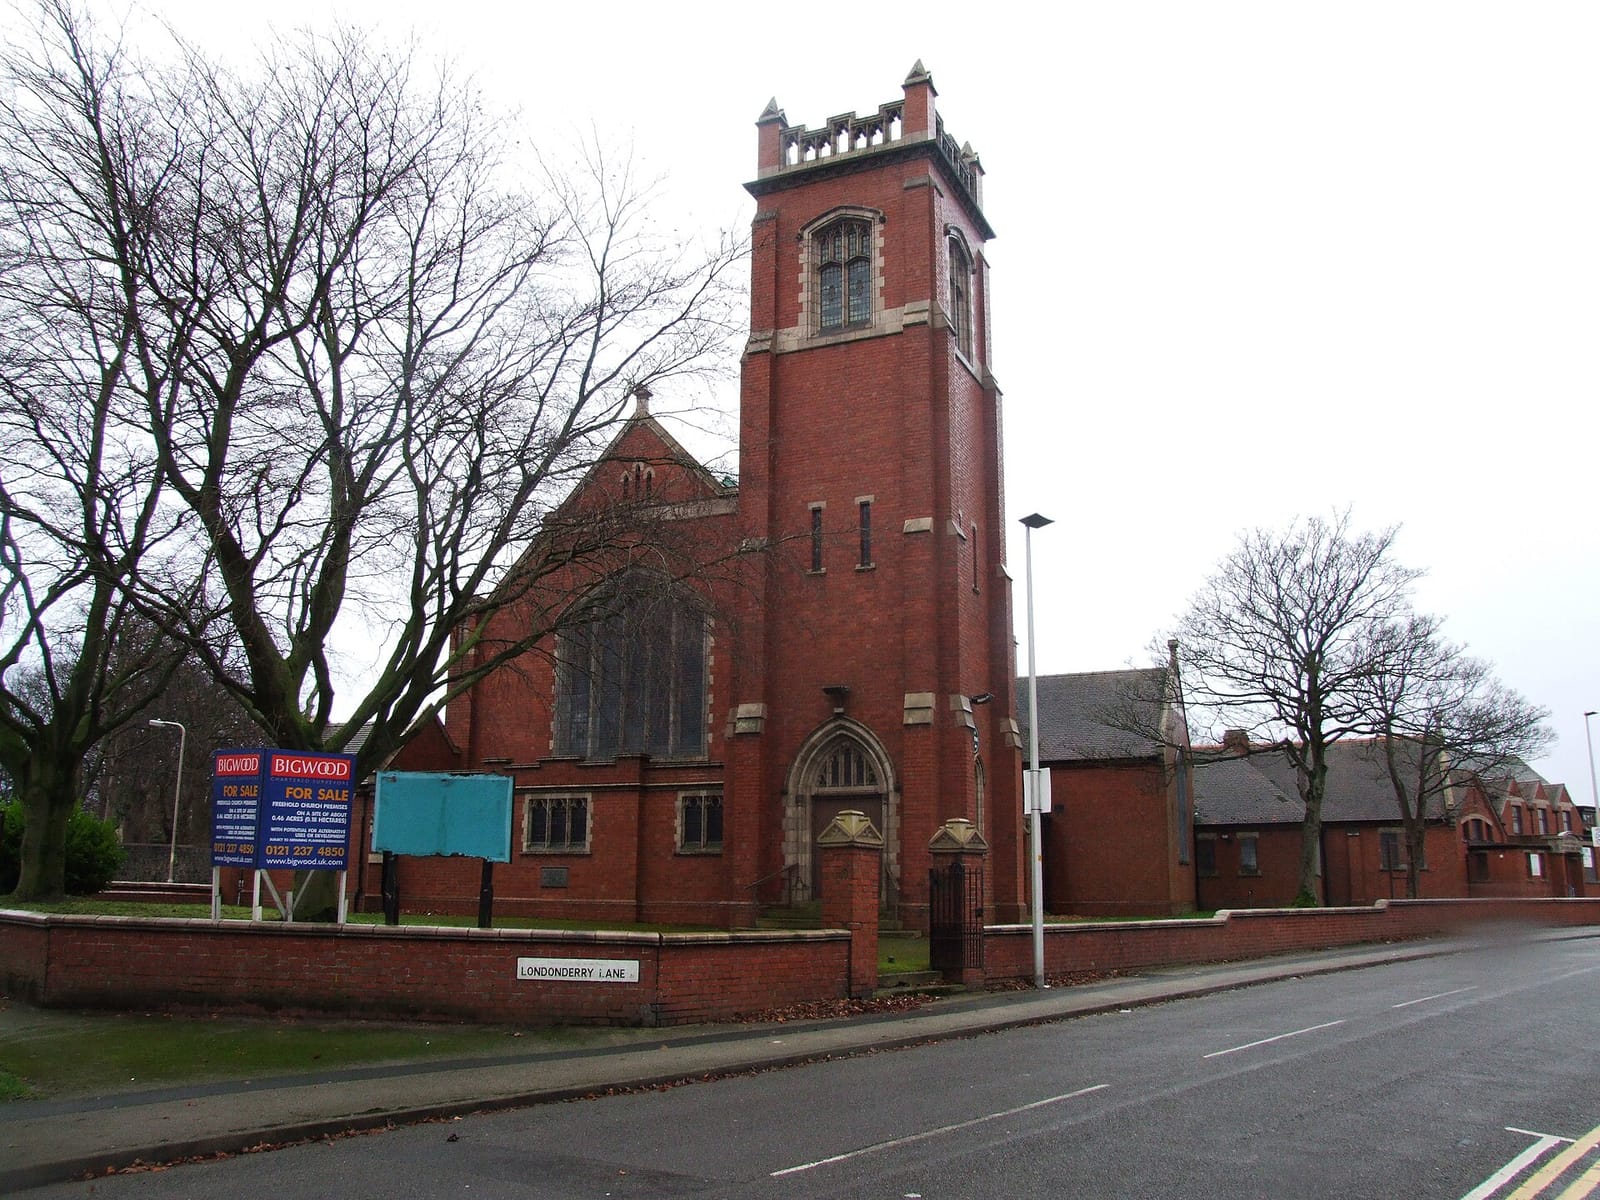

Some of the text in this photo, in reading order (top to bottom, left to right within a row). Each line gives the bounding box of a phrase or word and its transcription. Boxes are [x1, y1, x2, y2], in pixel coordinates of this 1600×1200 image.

[218, 758, 258, 772] BIGWOOD
[275, 758, 348, 776] BIGWOOD
[224, 785, 258, 797] FOR SALE
[286, 786, 349, 801] FOR SALE
[239, 844, 254, 854] 4850
[265, 845, 345, 857] 0121 237 4850
[266, 858, 343, 866] www.bigwood.uk.com
[520, 966, 626, 978] LONDONDERRY LANE
